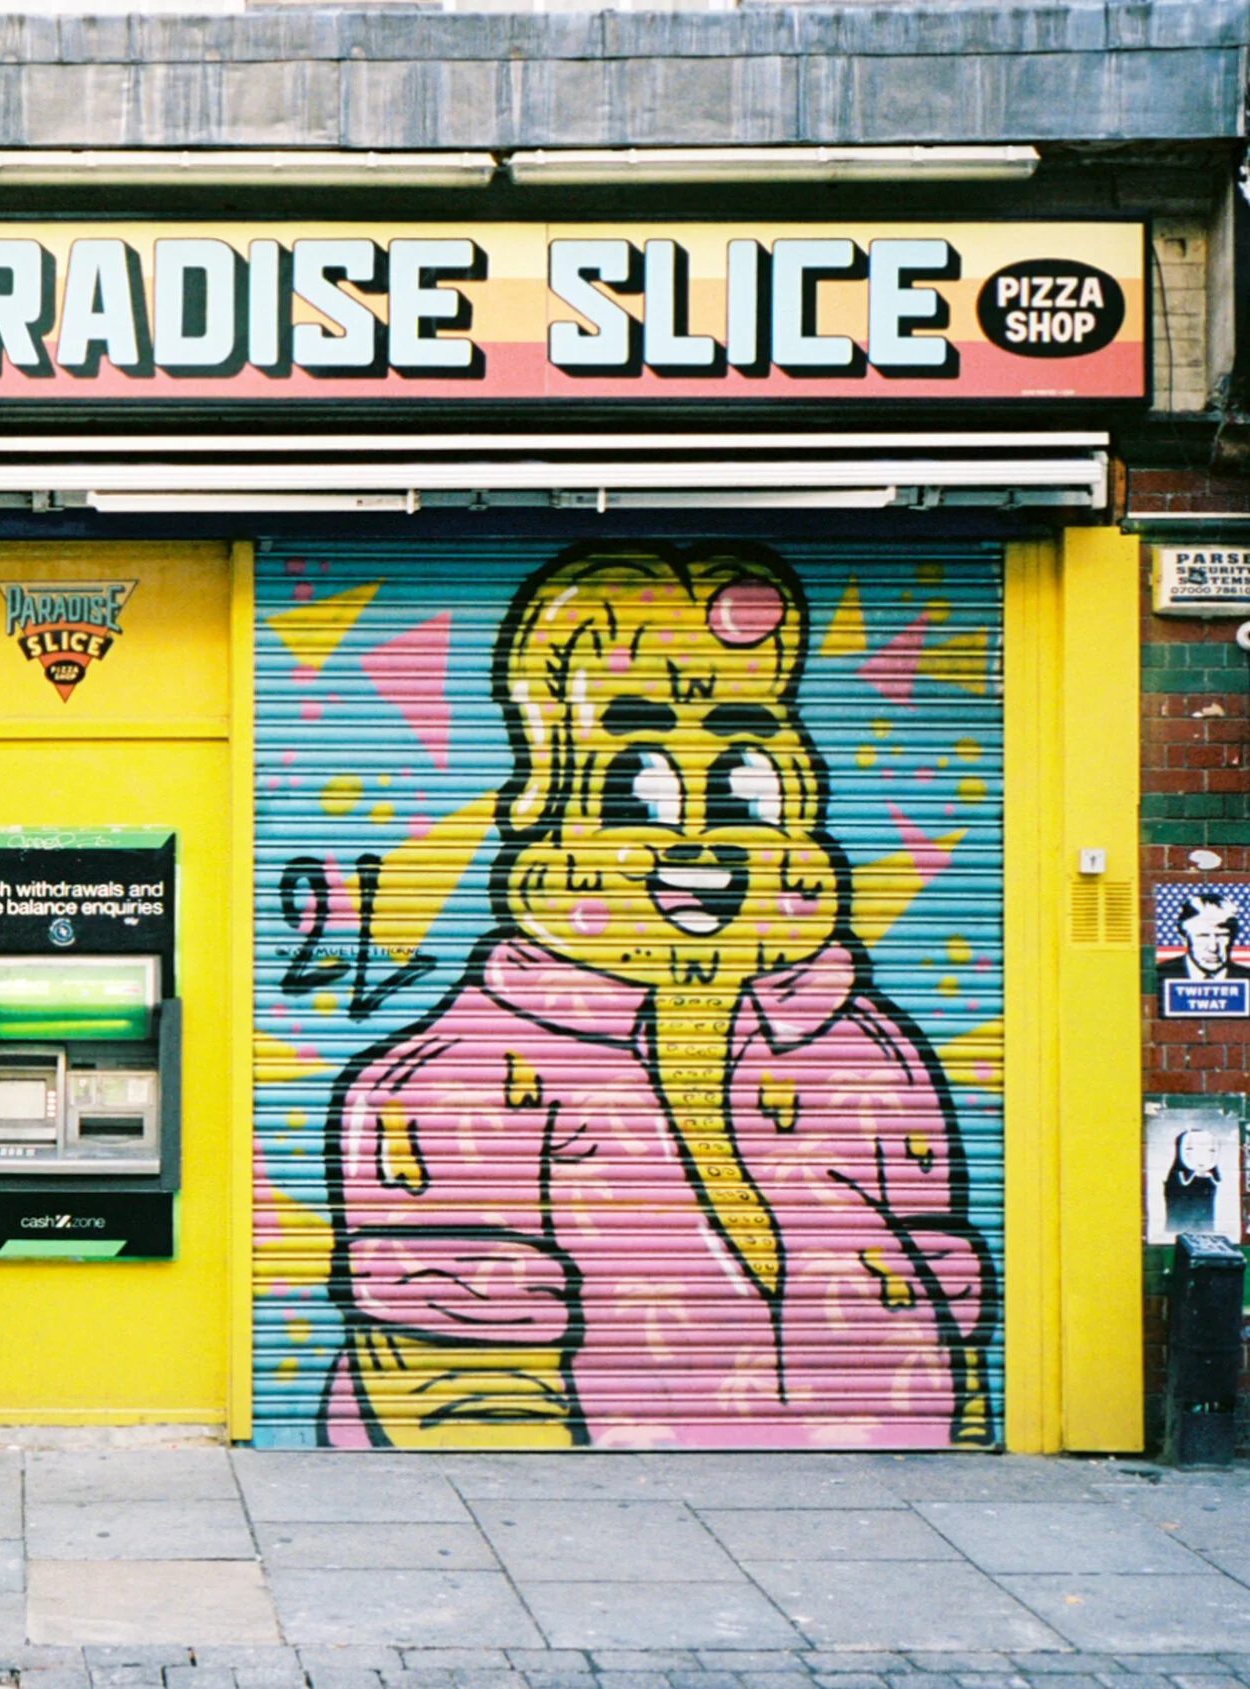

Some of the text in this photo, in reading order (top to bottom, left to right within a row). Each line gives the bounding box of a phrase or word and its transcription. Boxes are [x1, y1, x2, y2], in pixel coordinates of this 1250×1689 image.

[996, 276, 1104, 309] PIZZA
[548, 238, 962, 379] SLICE
[1005, 311, 1096, 343] SHOP
[6, 585, 126, 636] PARADISE
[27, 631, 104, 657] SLICE
[50, 665, 79, 674] PIZZA
[16, 881, 123, 897] withdrawals
[128, 881, 164, 897] and
[7, 899, 77, 915] balance
[81, 899, 163, 919] enquiries
[1175, 986, 1239, 996] TWITTER
[1187, 999, 1227, 1010] TWAT
[21, 1215, 54, 1228] cash
